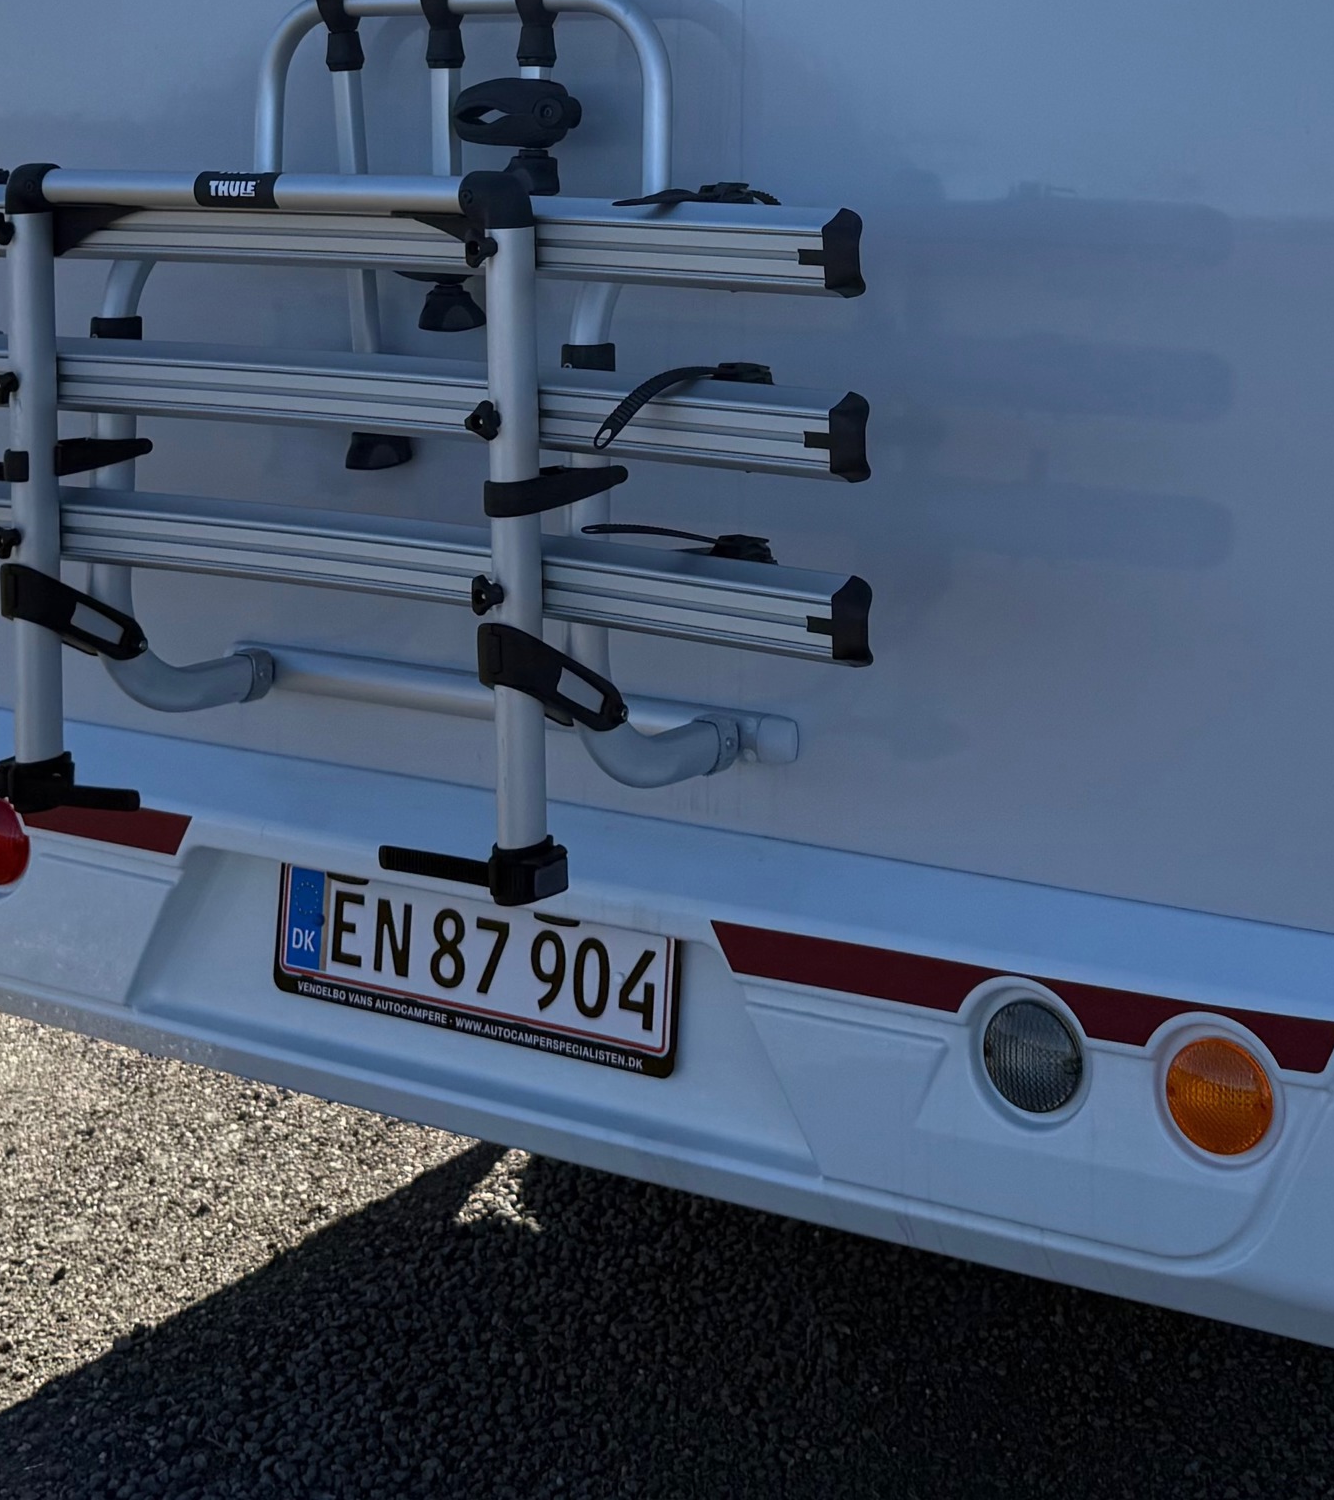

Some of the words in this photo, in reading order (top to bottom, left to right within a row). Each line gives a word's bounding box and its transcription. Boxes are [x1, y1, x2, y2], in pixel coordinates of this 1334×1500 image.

[208, 180, 257, 198] THULE
[291, 927, 316, 953] DK
[331, 890, 413, 978] EN
[430, 908, 510, 995] 87
[530, 929, 657, 1032] 904
[297, 980, 347, 1001] VENDELBO
[348, 991, 374, 1007] VANS
[374, 999, 448, 1024] AUTOCAMPERE
[455, 1016, 644, 1070] WWW.AUTOCAMPERSPECIALISTEN.DK
